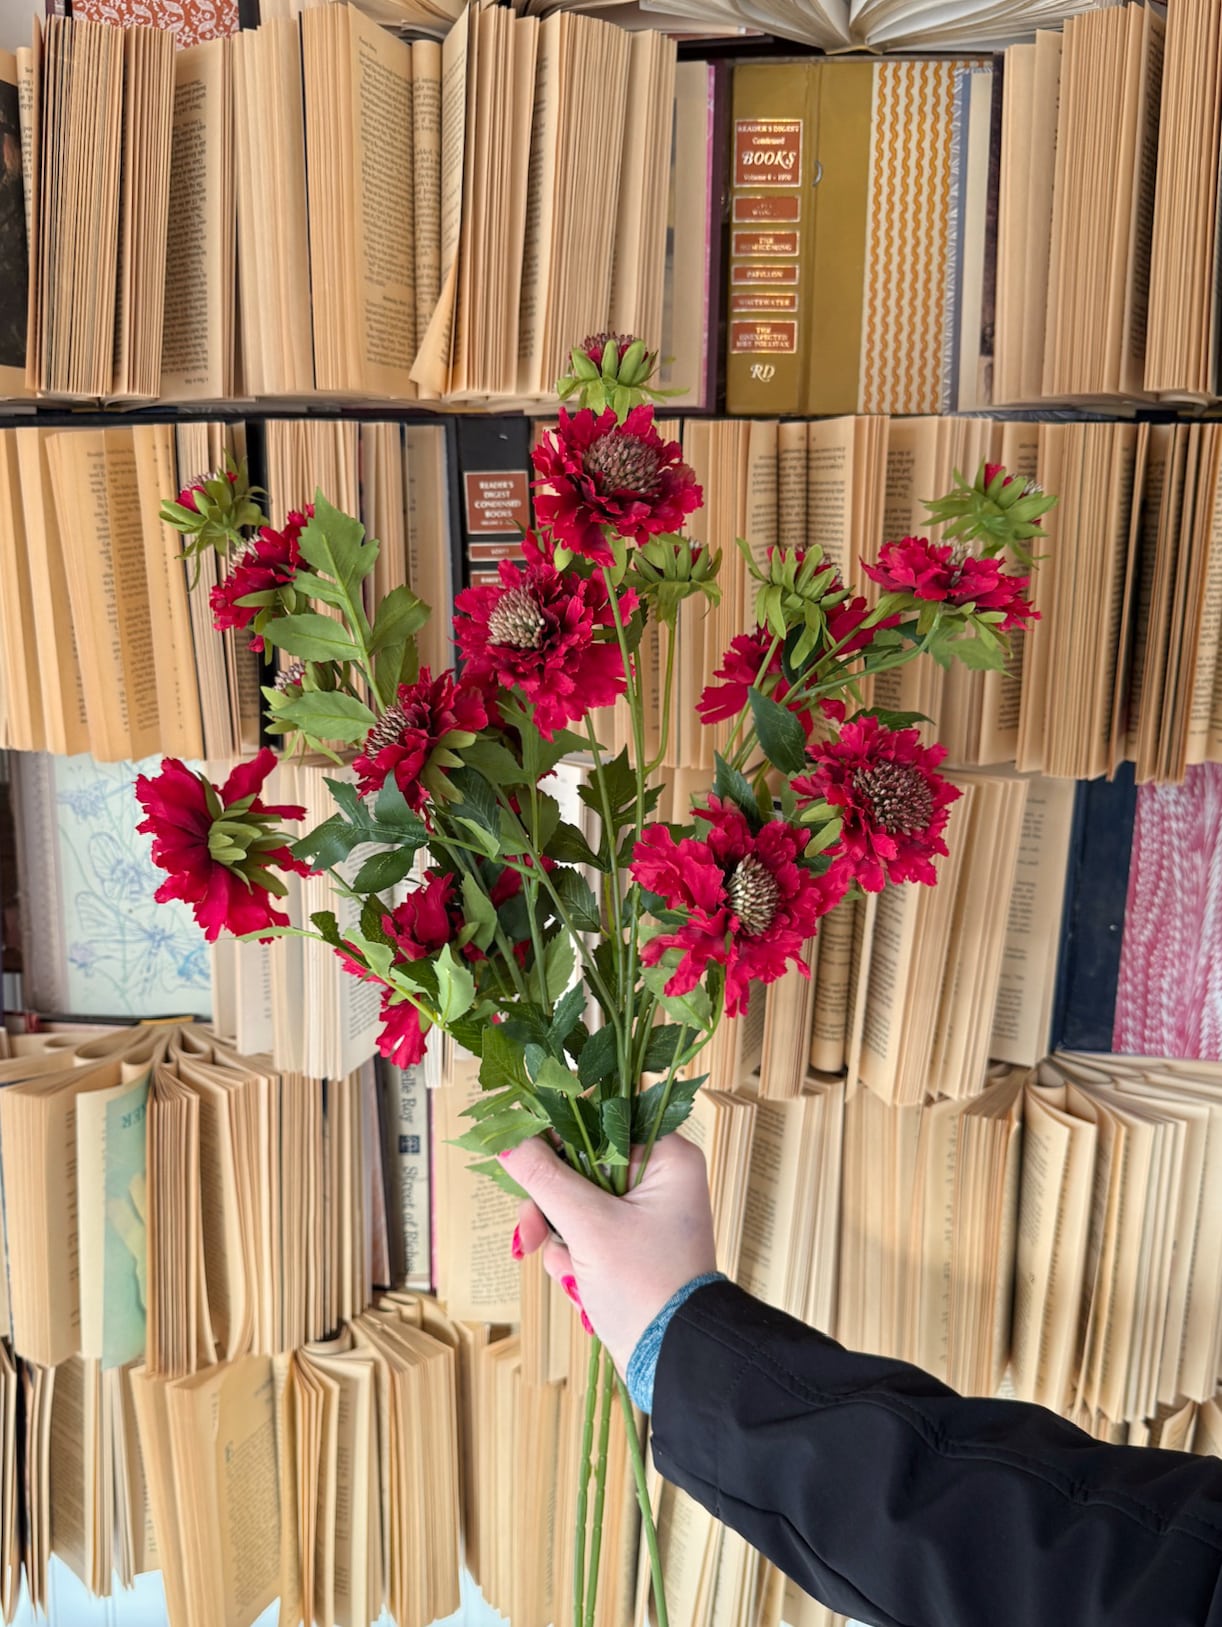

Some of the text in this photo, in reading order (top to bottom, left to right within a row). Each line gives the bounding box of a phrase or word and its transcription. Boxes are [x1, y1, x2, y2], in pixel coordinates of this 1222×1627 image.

[737, 125, 799, 133] READER'S DIGEST
[742, 150, 797, 170] BOOKS
[743, 173, 766, 181] Volume
[750, 363, 775, 382] RD
[479, 481, 515, 490] READER'S
[483, 490, 510, 499] DIGEST
[474, 499, 522, 509] CONDENSED
[484, 509, 513, 518] BOOKS
[397, 1098, 416, 1123] Roy
[402, 1166, 420, 1274] Street of Riches
